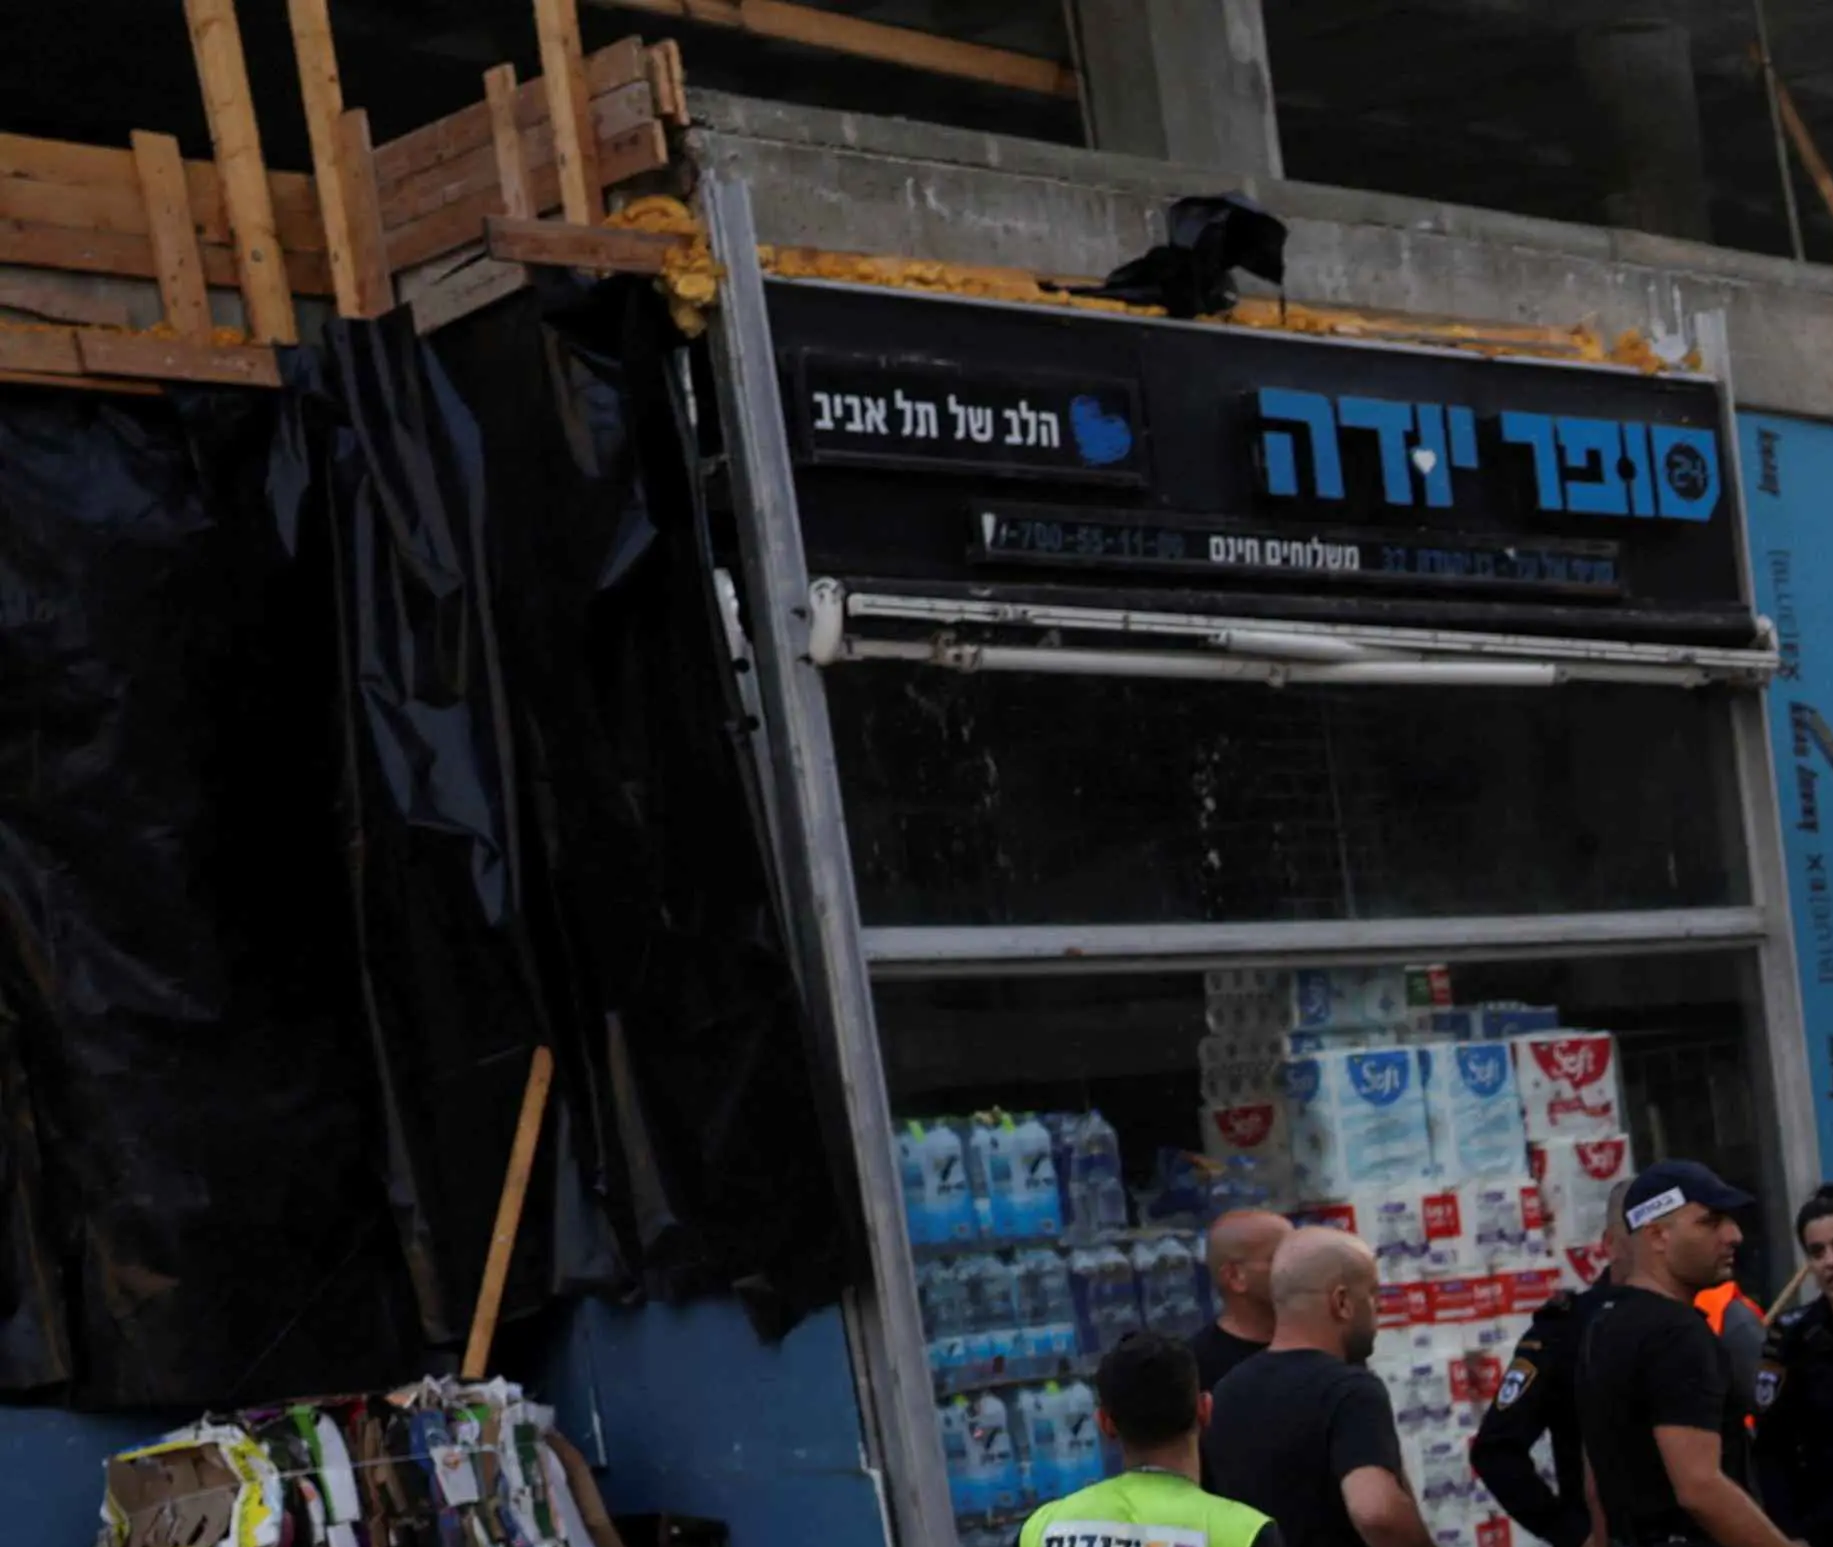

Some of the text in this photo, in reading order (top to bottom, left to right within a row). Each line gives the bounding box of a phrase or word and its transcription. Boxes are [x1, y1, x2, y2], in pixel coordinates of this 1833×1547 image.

[813, 388, 1060, 448] הלב של תל אביב
[1258, 386, 1721, 521] סופר יודה
[1671, 453, 1706, 488] 24
[1209, 535, 1360, 571] משלוחים חינם
[1359, 1060, 1400, 1096] Soft
[1549, 1041, 1595, 1082] Soft
